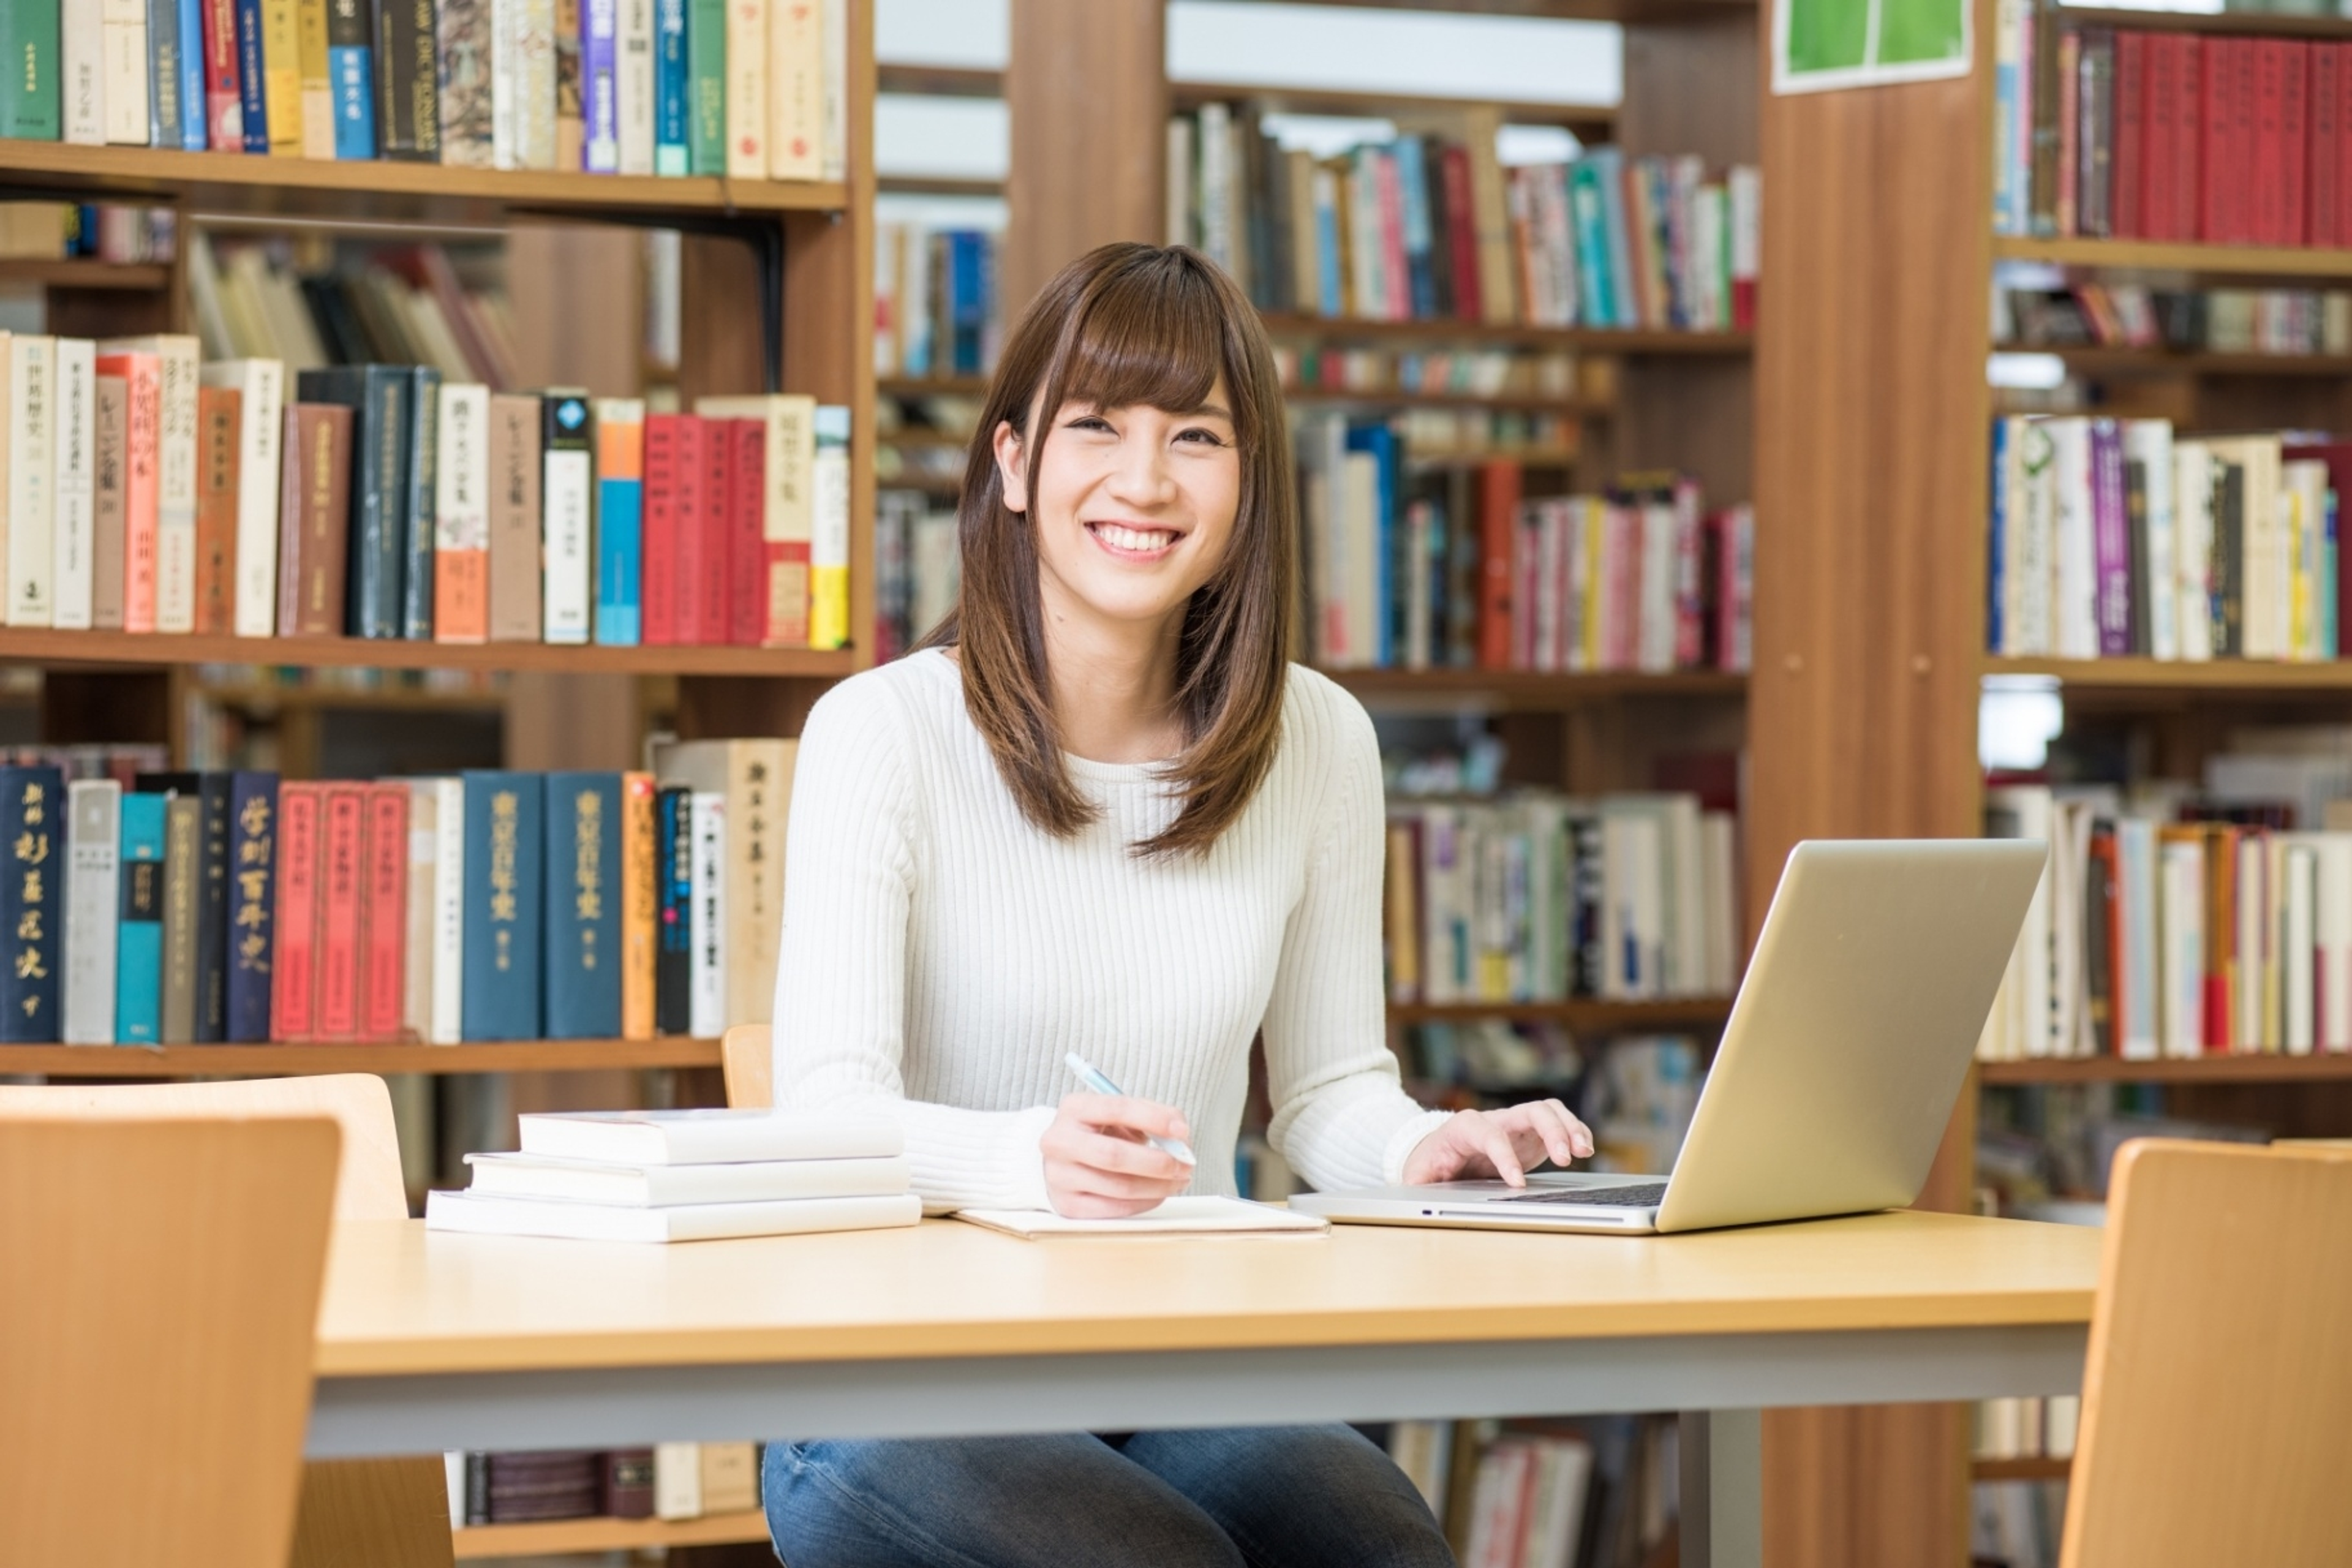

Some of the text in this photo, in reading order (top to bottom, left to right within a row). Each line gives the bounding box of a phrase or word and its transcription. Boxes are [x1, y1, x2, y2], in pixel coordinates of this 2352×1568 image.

[100, 395, 120, 491] レーニン全集
[130, 371, 156, 475] 小児科の本
[507, 413, 527, 507] レーニン全集
